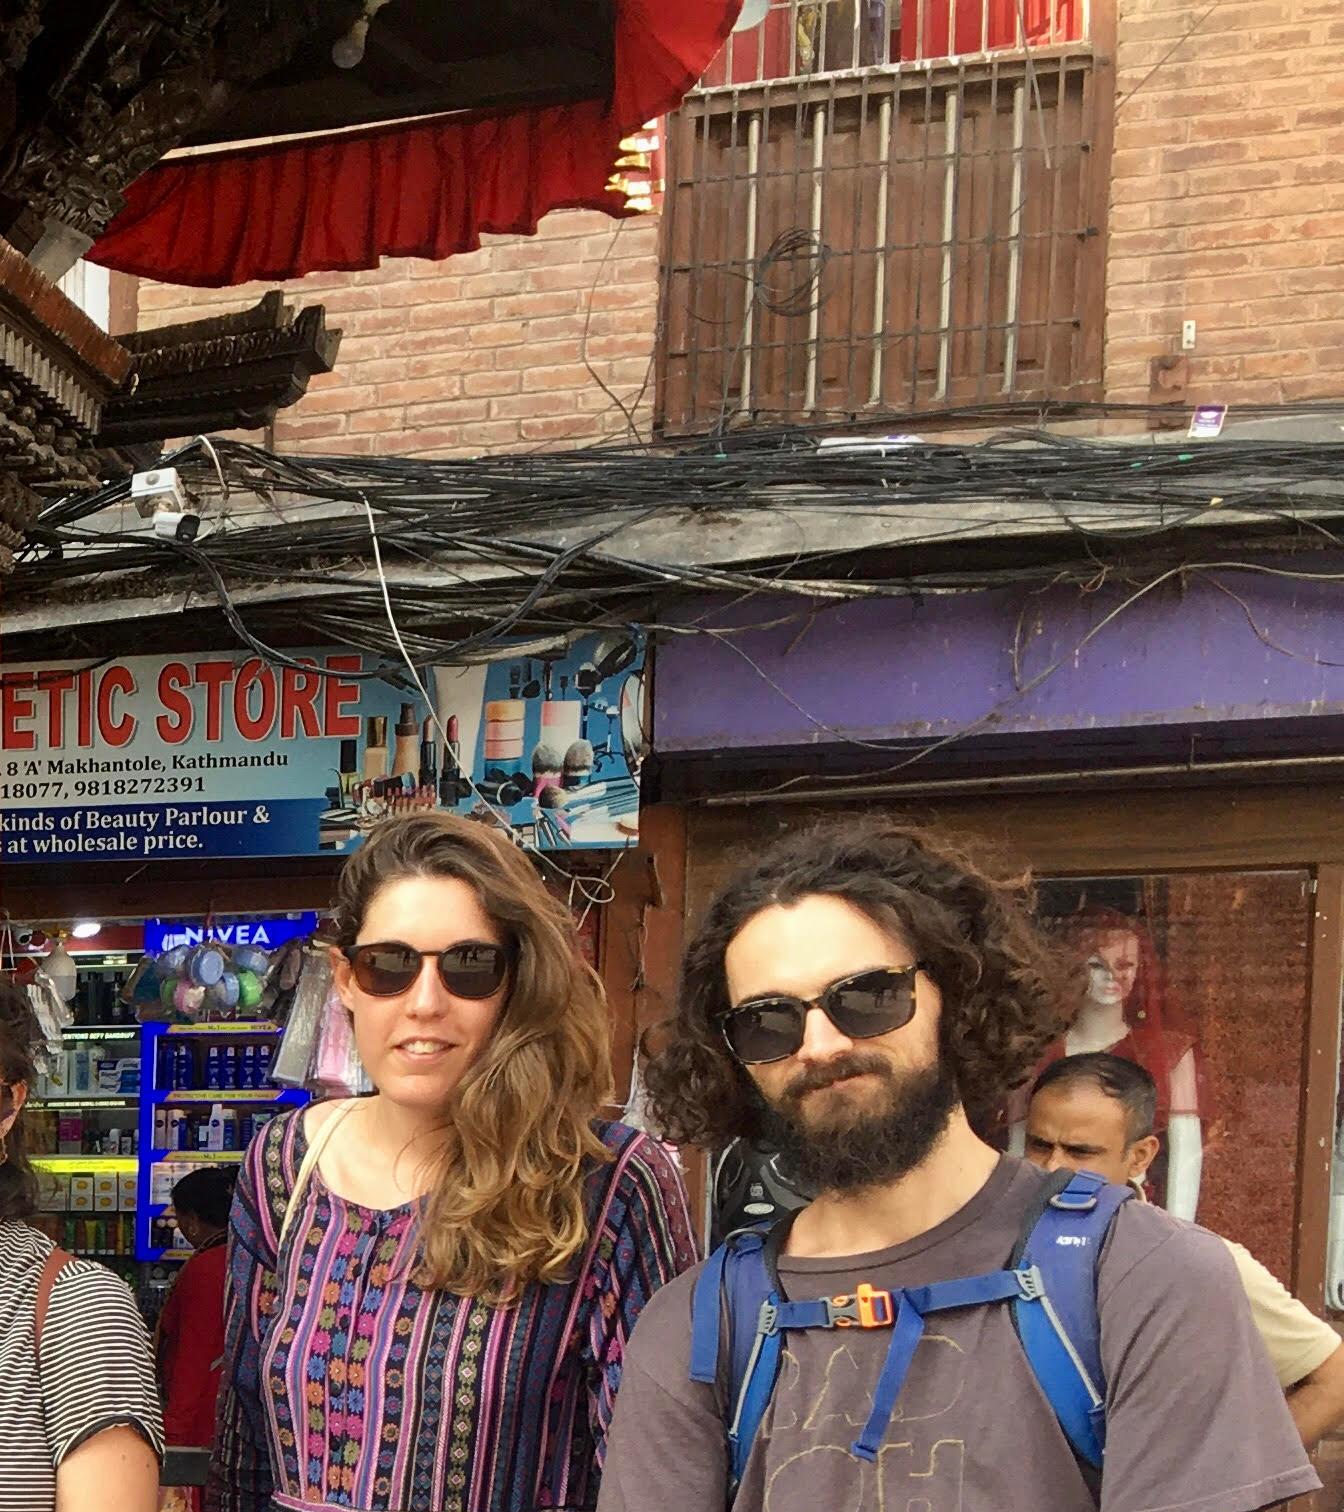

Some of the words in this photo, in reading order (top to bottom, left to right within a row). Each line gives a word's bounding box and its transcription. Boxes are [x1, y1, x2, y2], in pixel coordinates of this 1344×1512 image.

[155, 653, 362, 745] STORE
[6, 761, 19, 777] 8
[47, 755, 166, 775] Makhantole,
[172, 751, 289, 770] Kathmandu
[74, 776, 206, 797] 9818272391
[0, 811, 55, 832] kinds
[60, 810, 83, 831] of
[86, 809, 160, 833] Beauty
[165, 806, 248, 828] Parlour
[252, 805, 271, 825] &
[7, 836, 29, 854] at
[33, 831, 138, 854] wholesale
[143, 830, 204, 855] price.
[185, 924, 271, 945] NIVEA
